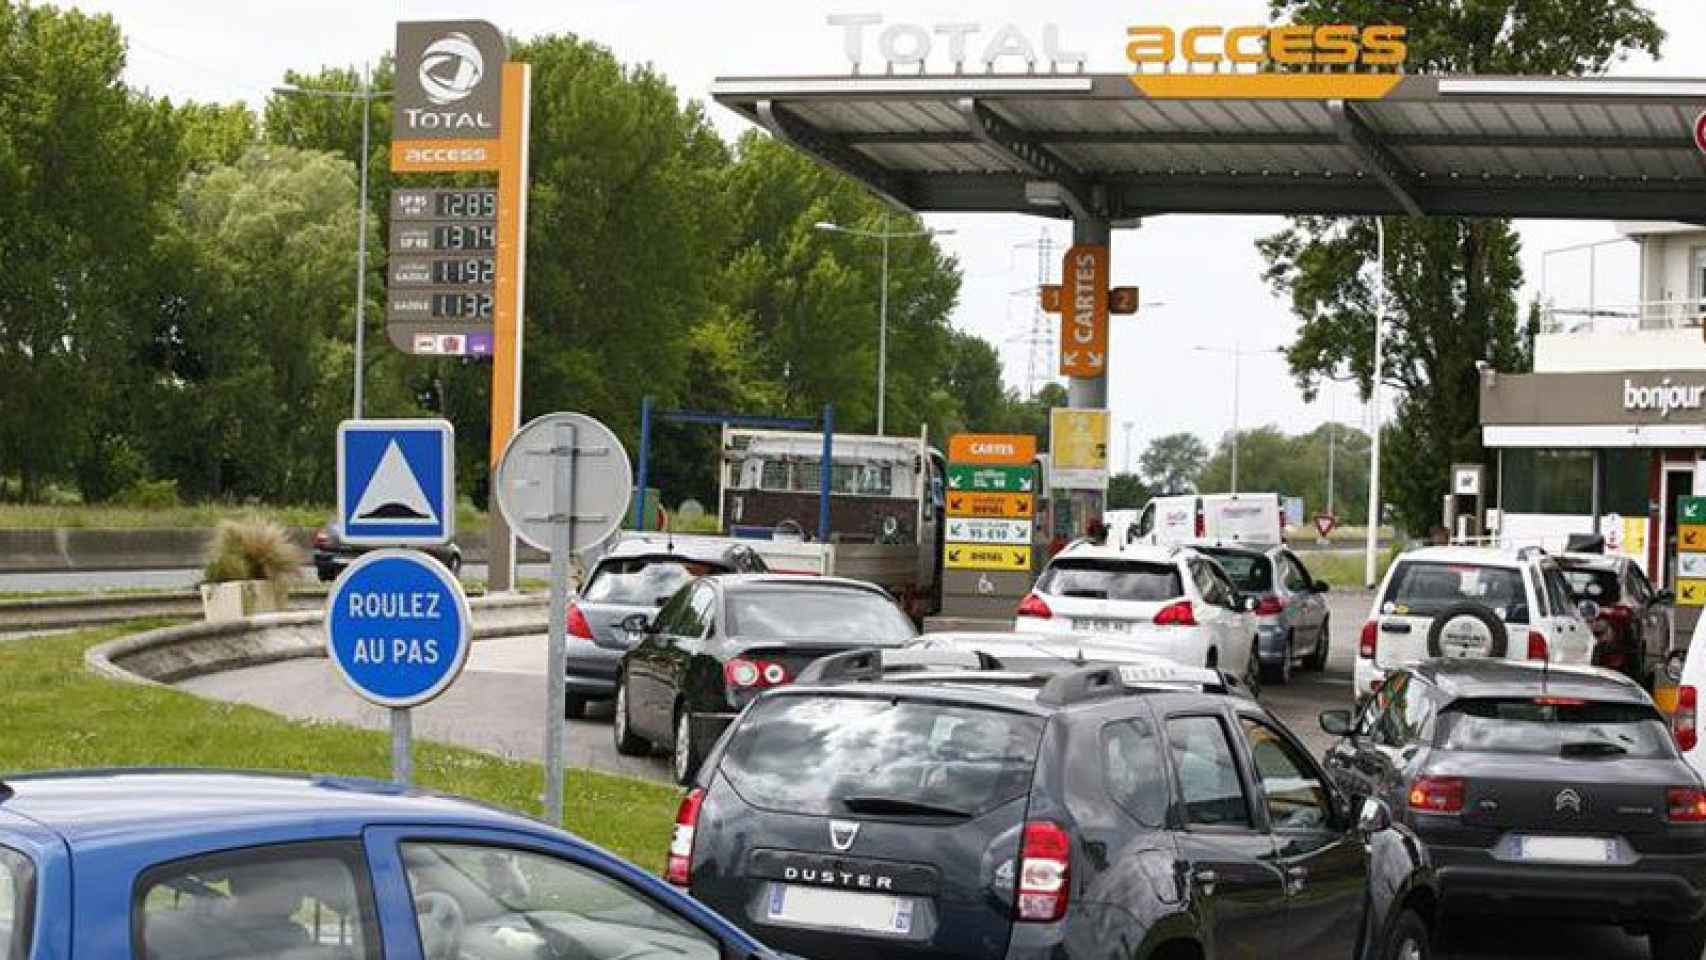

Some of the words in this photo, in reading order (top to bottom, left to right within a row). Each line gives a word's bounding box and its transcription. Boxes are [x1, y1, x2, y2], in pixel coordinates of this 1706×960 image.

[827, 13, 1088, 64] TOTAL
[1126, 24, 1408, 63] access
[403, 108, 492, 128] TOTAL
[405, 148, 487, 161] access
[443, 226, 496, 249] 1374
[443, 259, 496, 283] 1192
[441, 293, 494, 318] 1132
[1073, 254, 1096, 344] CARTES
[1624, 377, 1705, 417] bonjour
[970, 442, 1015, 456] CARTES
[350, 592, 441, 618] ROULEZ
[353, 638, 385, 665] AU
[393, 638, 440, 665] PAS
[784, 866, 893, 889] DUSTER
